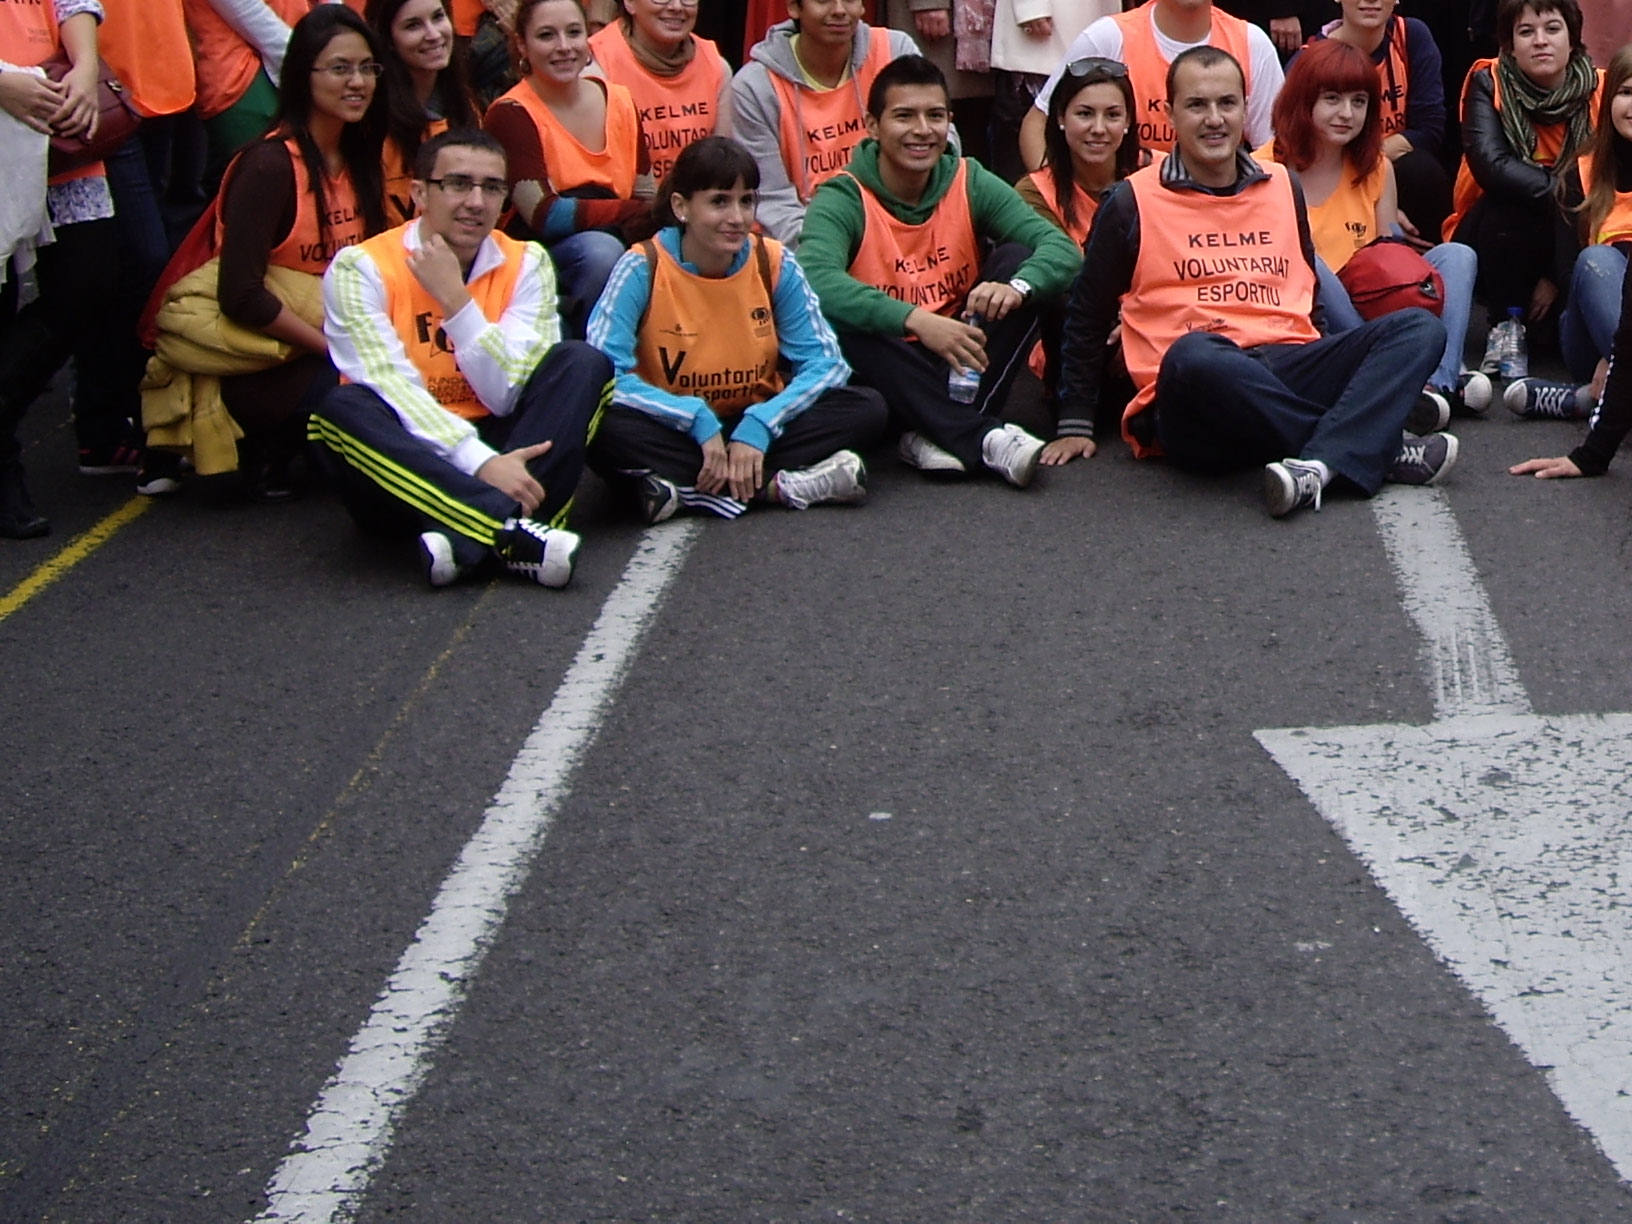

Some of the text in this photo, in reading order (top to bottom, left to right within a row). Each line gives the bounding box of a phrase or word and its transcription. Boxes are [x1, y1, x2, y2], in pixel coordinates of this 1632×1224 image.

[640, 102, 709, 122] KELME
[1188, 231, 1273, 249] KELME
[1173, 257, 1290, 280] VOLUNTARIAT
[1197, 281, 1281, 307] ESPORTIU
